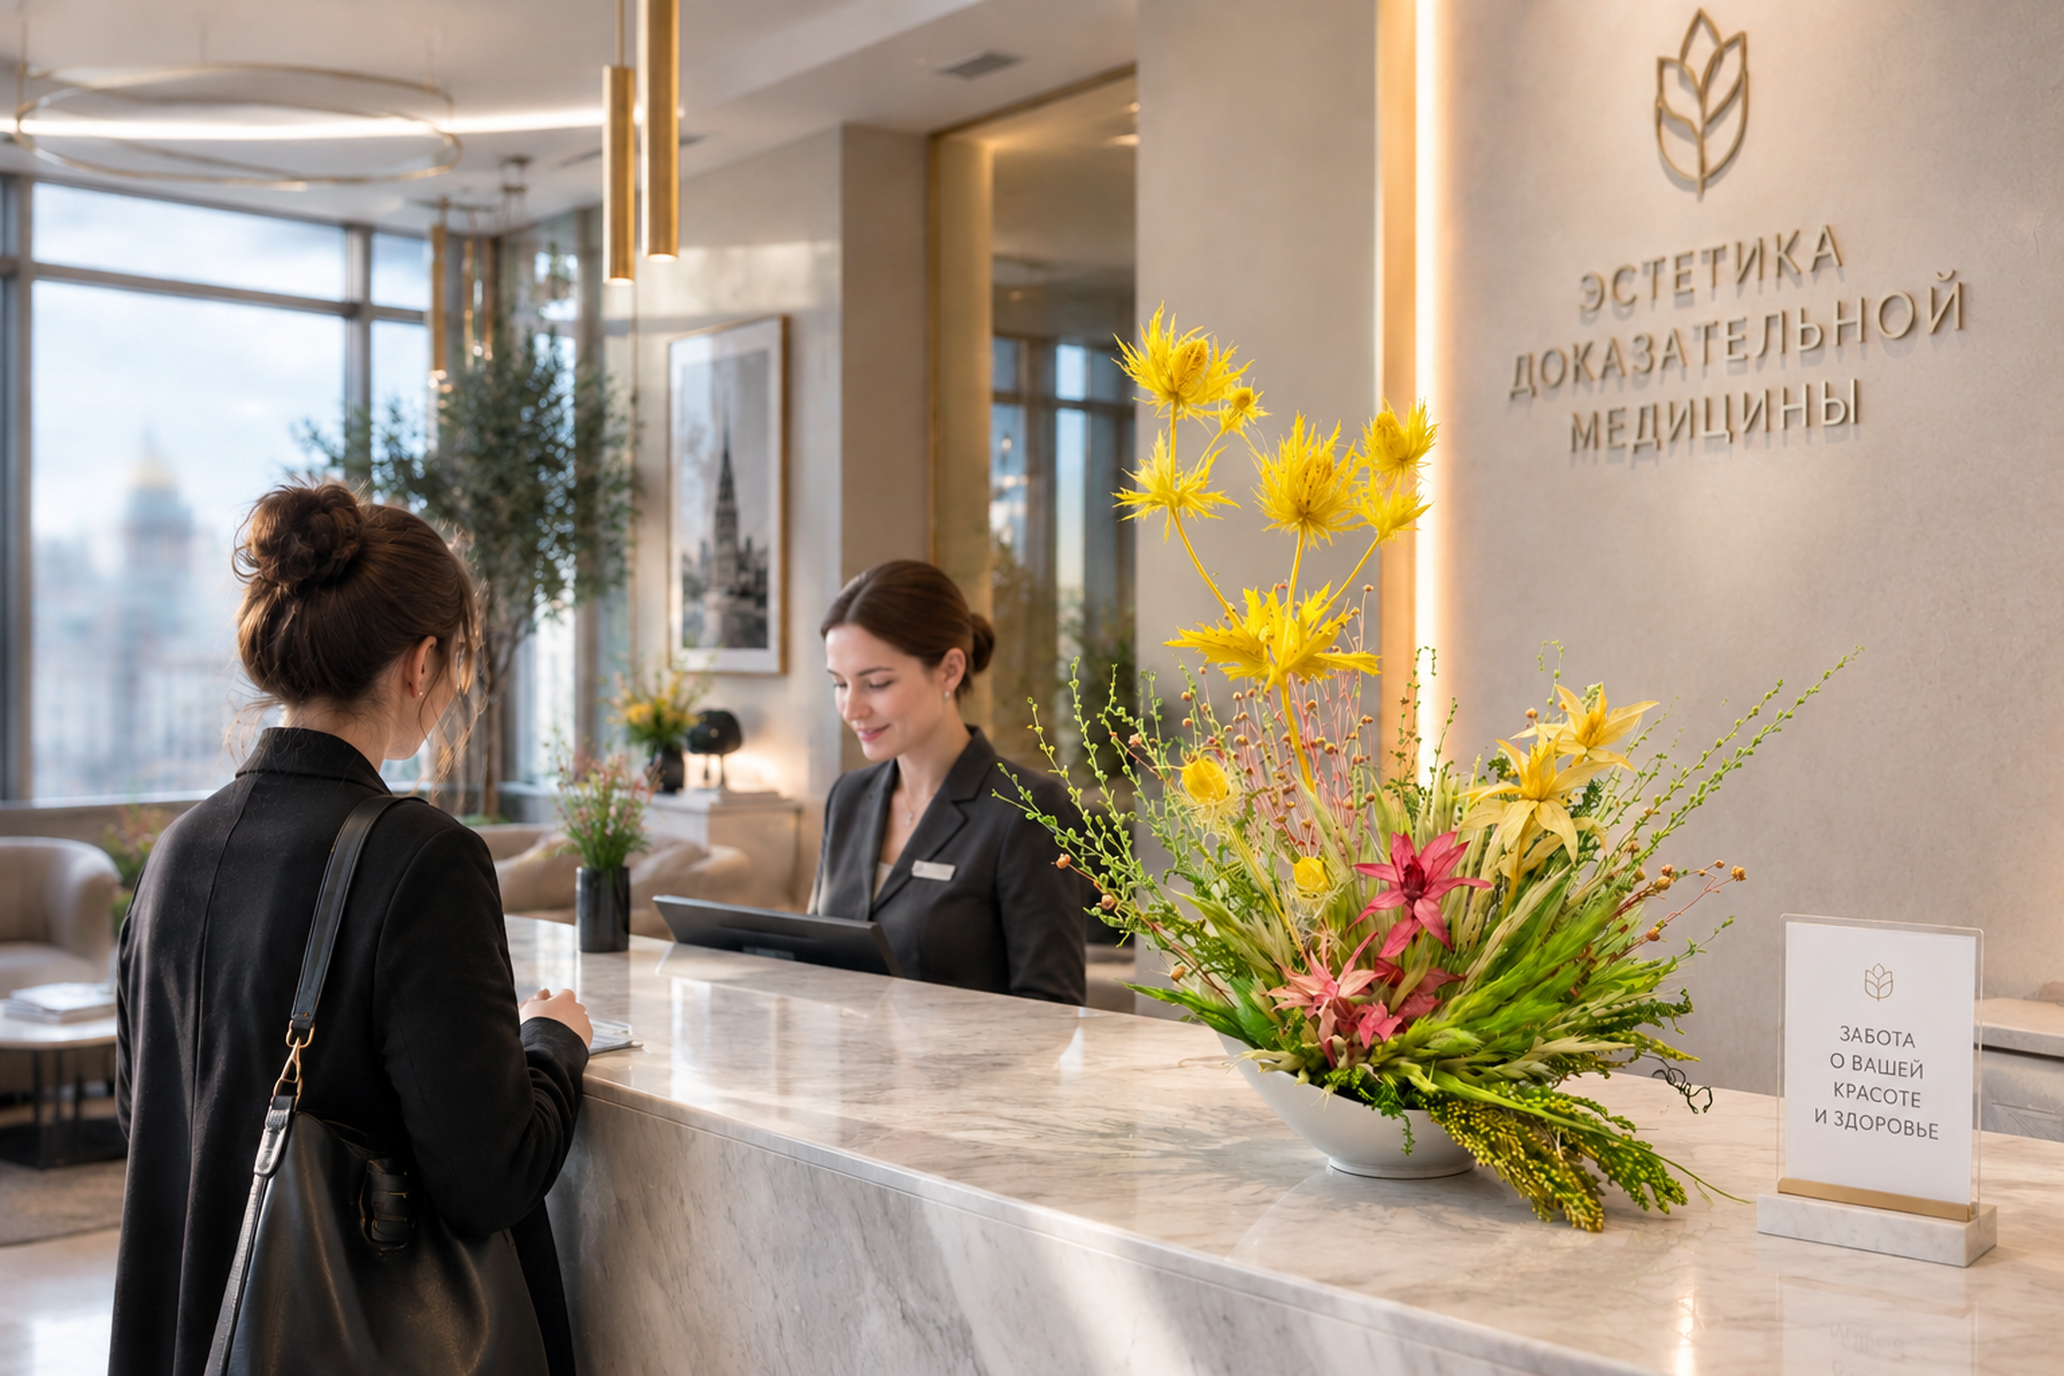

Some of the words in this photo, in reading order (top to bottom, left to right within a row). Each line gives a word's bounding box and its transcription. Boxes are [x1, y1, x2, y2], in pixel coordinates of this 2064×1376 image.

[1579, 224, 1842, 312] ЭСТЕТИКА
[1509, 269, 1964, 399] ДОКАЗАТЕЛЬНОЙ
[1570, 378, 1858, 453] МЕДИЦИНЫ
[1839, 1025, 1916, 1049] ЗАБОТА
[1830, 1052, 1845, 1069] О
[1851, 1054, 1924, 1079] ВАШЕЙ
[1833, 1082, 1921, 1108] КРАСОТЕ
[1814, 1108, 1827, 1124] И
[1833, 1110, 1939, 1140] ЗДОРОВЬЕ
